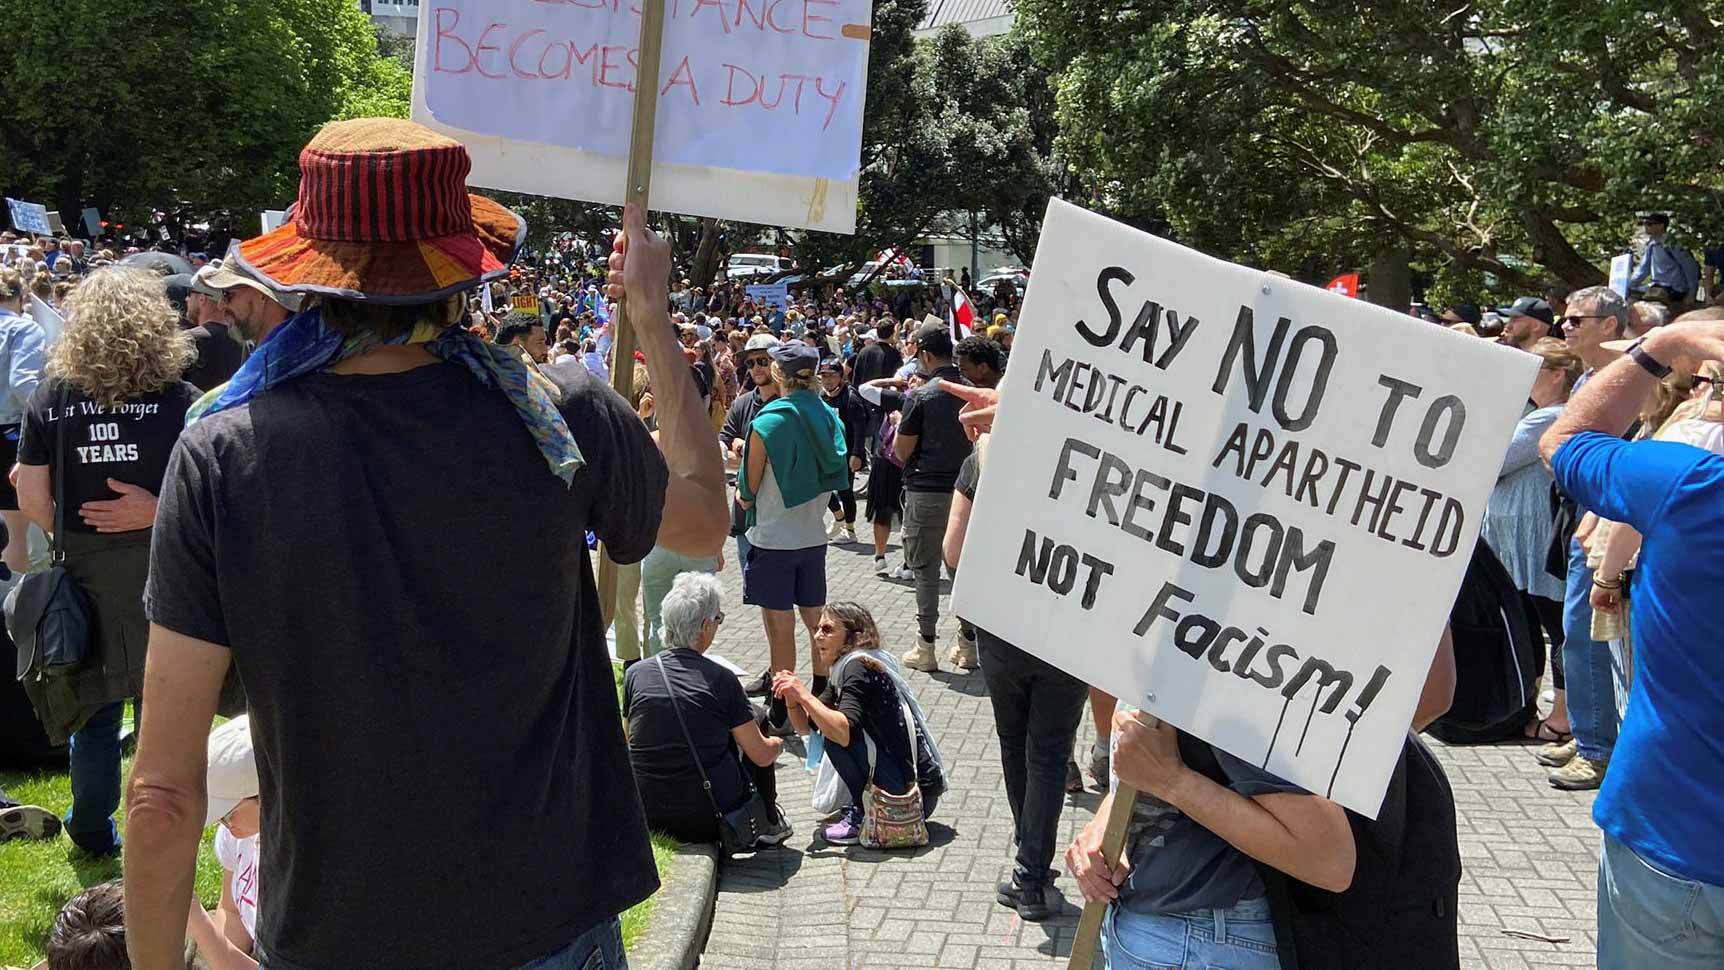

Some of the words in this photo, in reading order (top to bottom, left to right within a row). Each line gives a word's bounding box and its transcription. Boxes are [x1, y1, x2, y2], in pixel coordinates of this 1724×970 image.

[434, 8, 639, 92] BECOMES
[661, 55, 700, 107] A
[720, 63, 846, 131] DUTY
[48, 404, 75, 422] Lst
[80, 401, 105, 416] We
[89, 423, 119, 441] 100
[1075, 267, 1200, 371] SAY
[1212, 305, 1339, 432] NO
[1371, 374, 1466, 469] TO
[77, 444, 138, 463] YEARS
[1034, 349, 1188, 456] MEDICAL
[1213, 422, 1465, 558] APARTHEID
[1048, 438, 1335, 616] FREEDOM
[1015, 529, 1114, 610] NOT
[1133, 582, 1392, 723] Facism!
